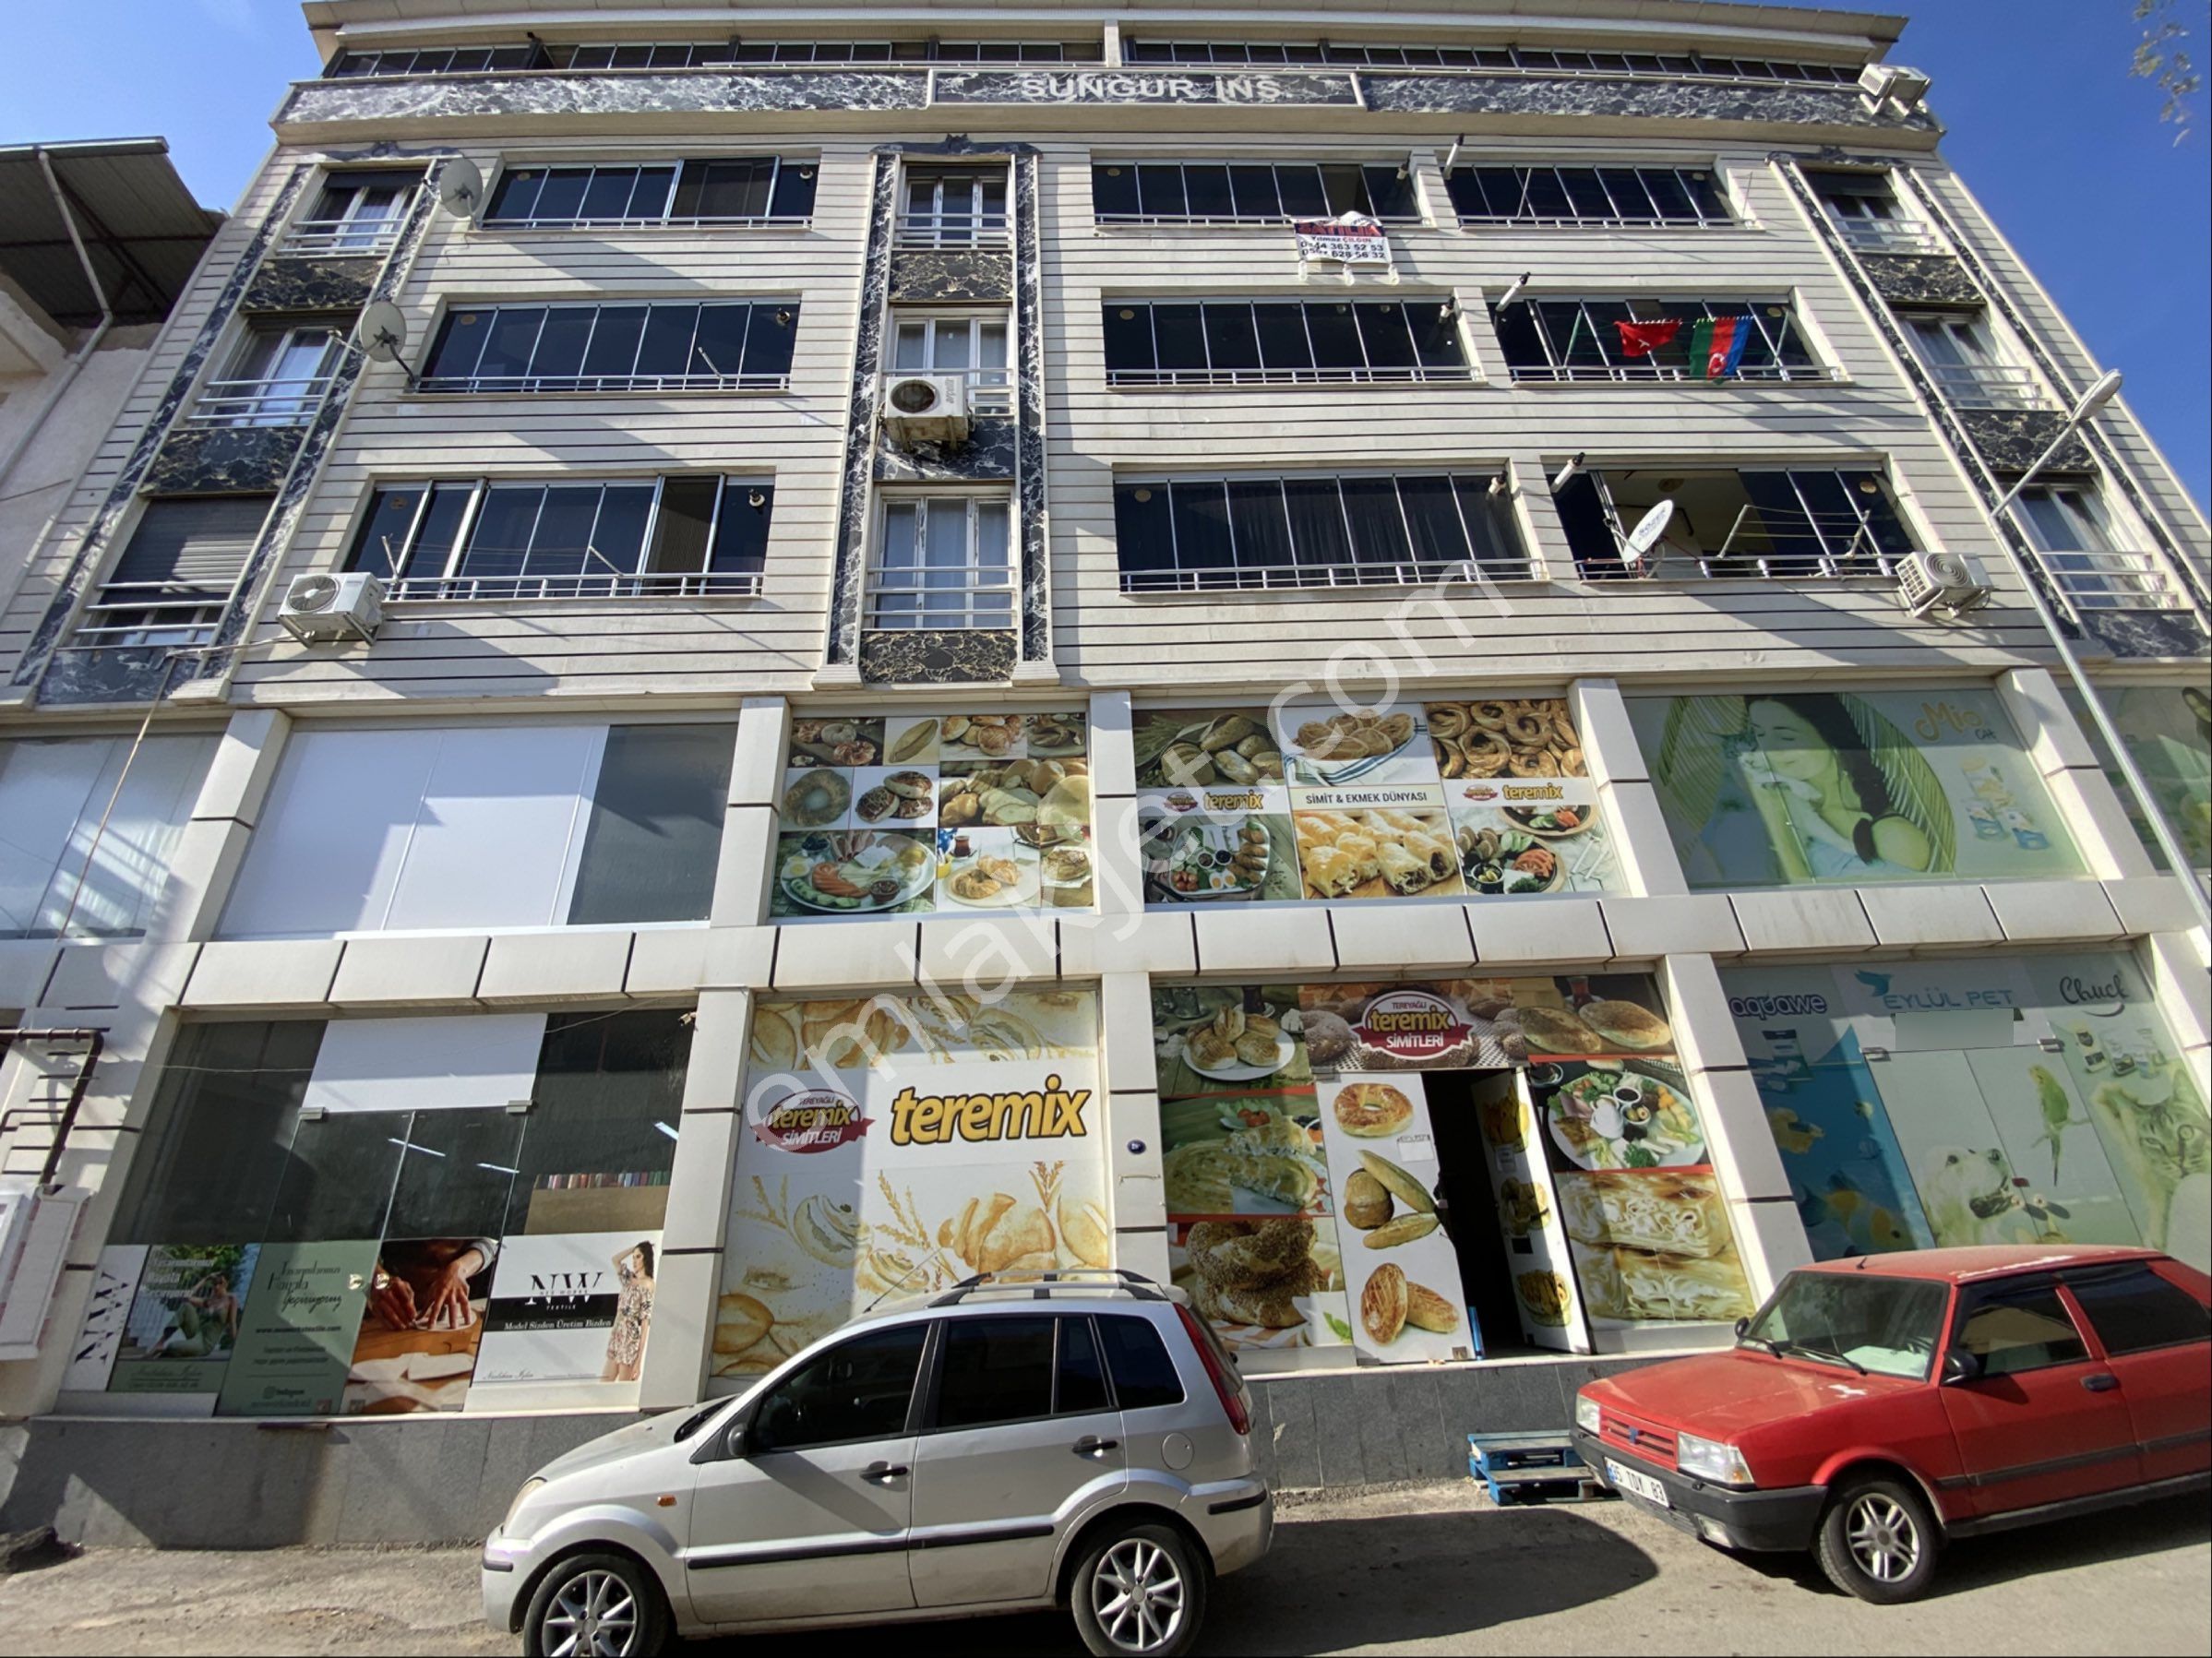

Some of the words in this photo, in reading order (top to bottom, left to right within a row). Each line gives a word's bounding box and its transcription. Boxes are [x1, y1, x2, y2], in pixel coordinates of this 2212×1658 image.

[1022, 79, 1197, 99] SUNGUR
[1203, 789, 1264, 811] teremix
[1306, 793, 1333, 805] SİMİT
[1336, 794, 1344, 804] &
[1346, 793, 1381, 803] EKMEK
[1384, 790, 1428, 802] DÜNYASI
[1502, 782, 1563, 800] teremix
[1883, 986, 1961, 1009] EYLÜL
[1966, 989, 2014, 1007] PET
[1369, 1004, 1453, 1032] teremix
[1385, 1032, 1444, 1049] SİMİTLERİ
[769, 1098, 858, 1129] teremix
[891, 1073, 1093, 1147] teremix
[782, 1127, 843, 1146] SİMİTLERİ
[504, 1321, 529, 1330] Model
[556, 1317, 583, 1329] Üretim
[586, 1316, 612, 1328] Bizden
